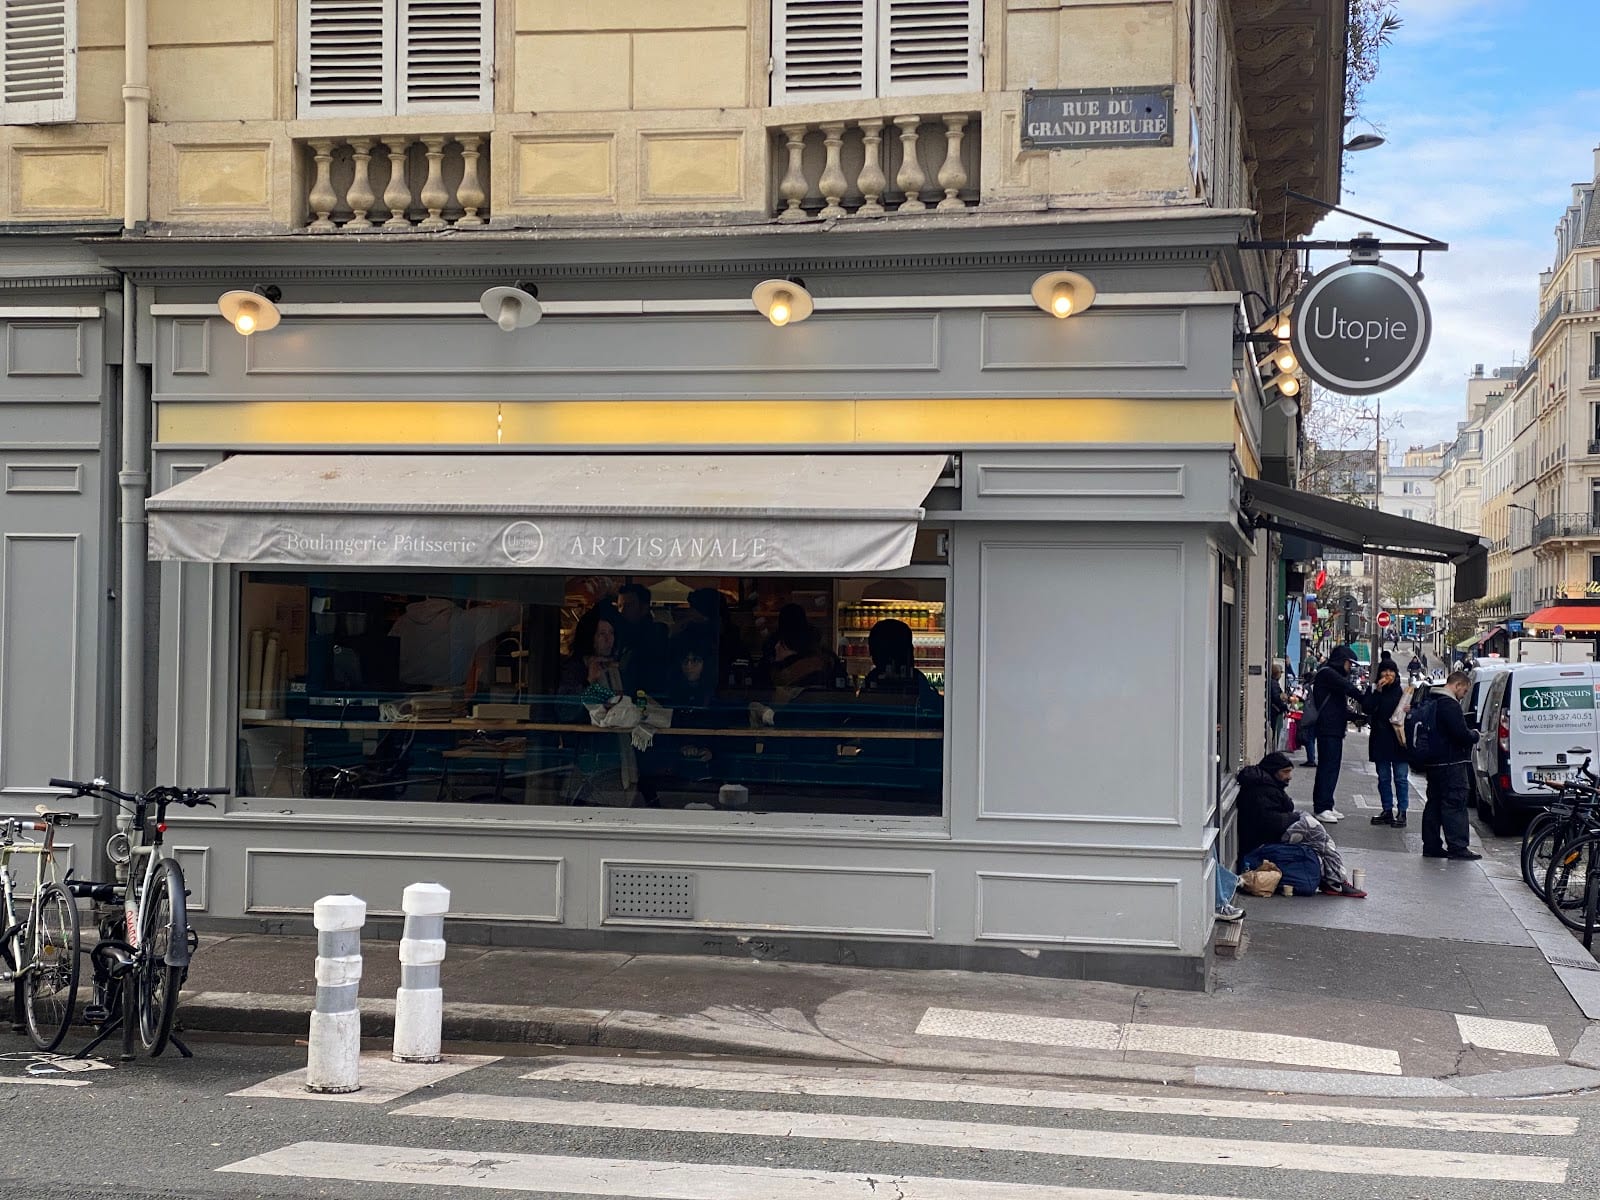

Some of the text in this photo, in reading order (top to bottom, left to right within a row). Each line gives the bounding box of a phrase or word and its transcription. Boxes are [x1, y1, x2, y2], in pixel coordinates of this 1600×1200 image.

[1062, 99, 1133, 117] RUE DU
[1028, 114, 1166, 137] GRAND PRIEURÉ
[1314, 307, 1407, 349] Utopie
[286, 532, 476, 555] Boulangerie Pâtisserie
[570, 535, 768, 558] ARTISANALE
[1522, 694, 1569, 709] CEPA
[1532, 689, 1591, 698] Ascenseurs
